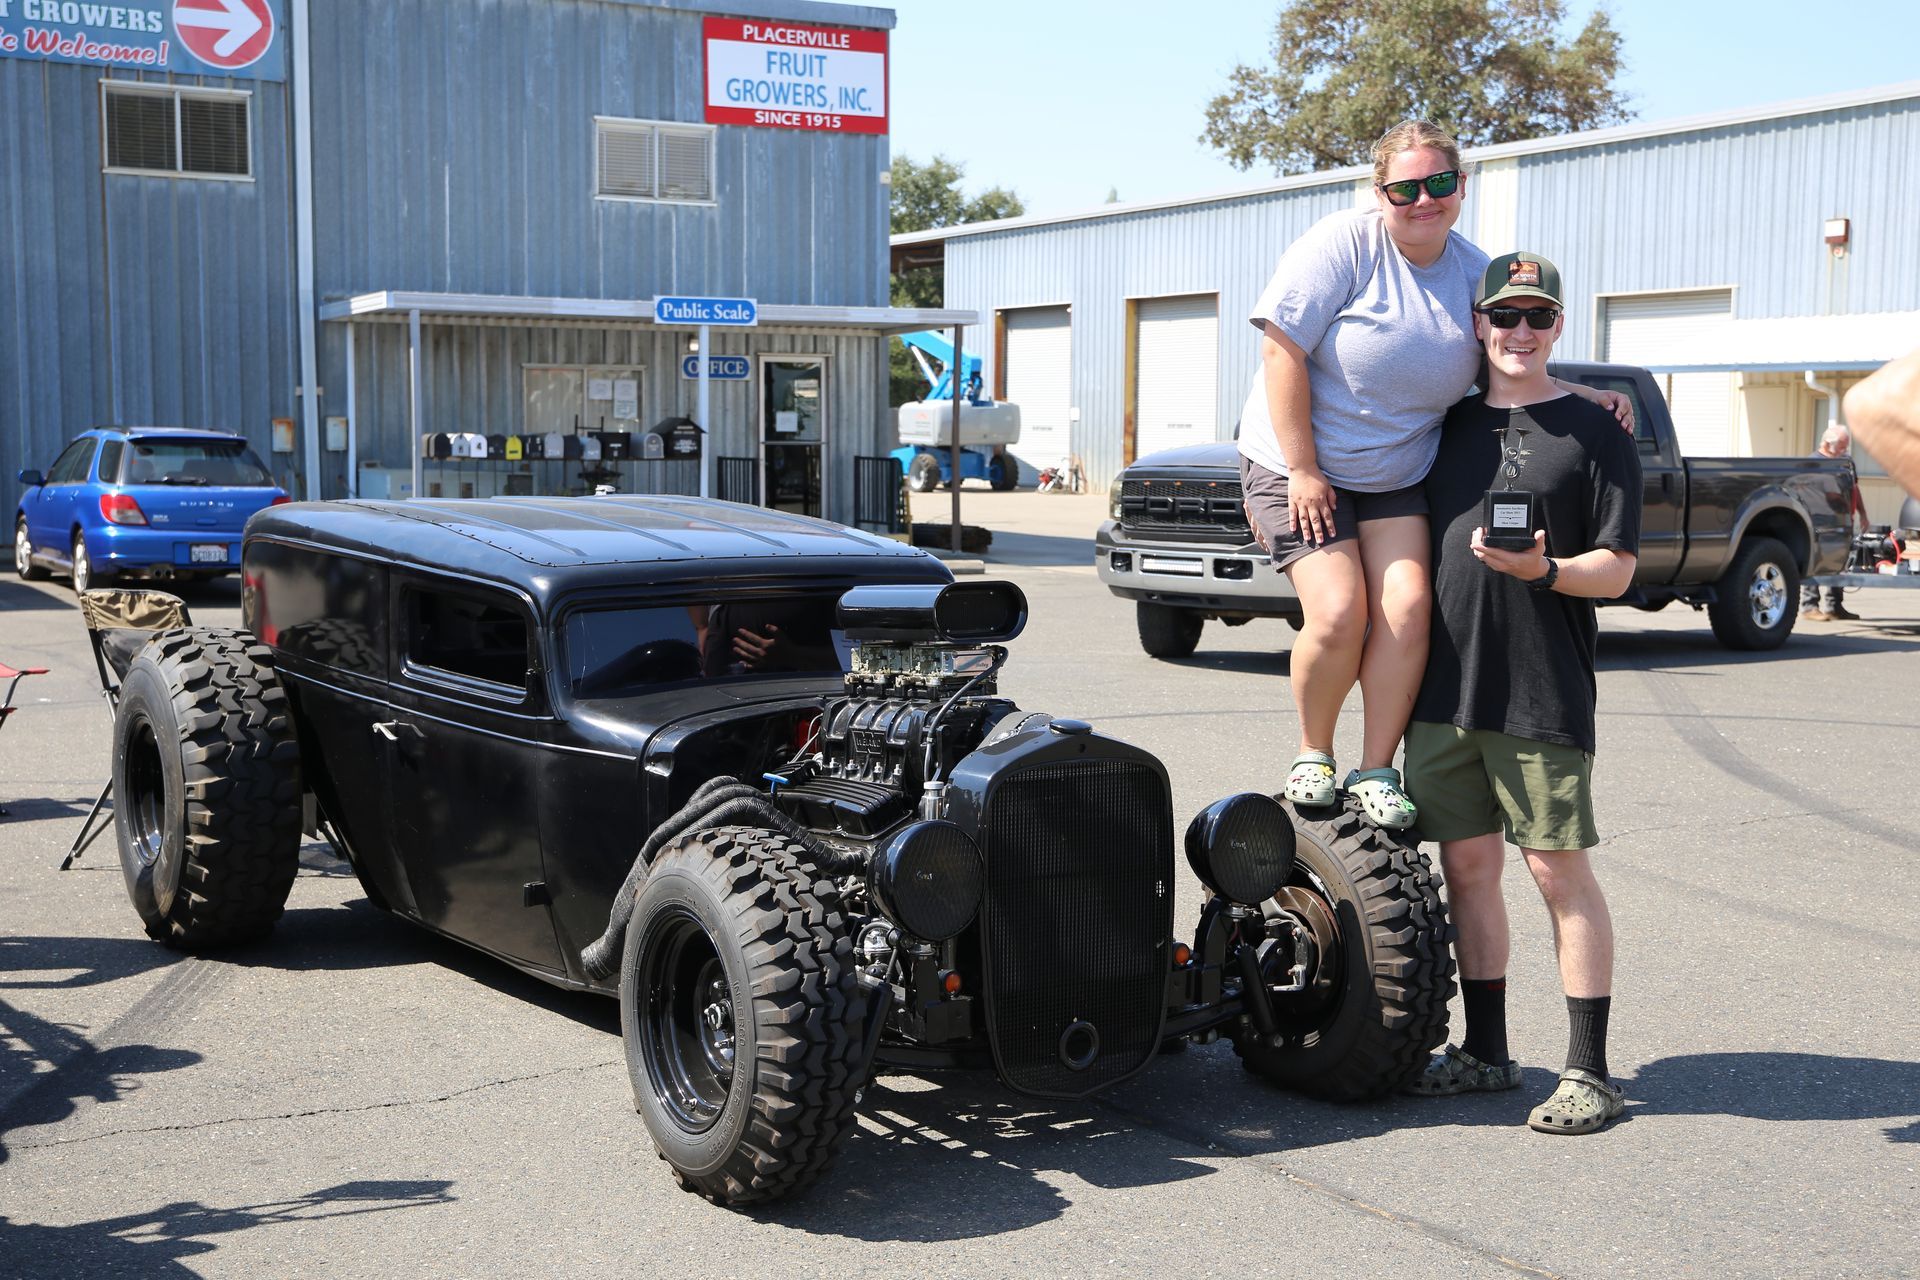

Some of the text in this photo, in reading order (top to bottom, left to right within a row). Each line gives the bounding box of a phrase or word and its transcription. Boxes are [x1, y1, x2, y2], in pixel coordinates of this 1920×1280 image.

[23, 0, 164, 34] GROWERS
[24, 26, 169, 66] Welcome!
[742, 24, 850, 48] PLACERVILLE
[766, 50, 827, 78] FRUIT
[726, 78, 872, 112] GROWERS, INC.
[754, 110, 842, 128] SINCE 1915
[662, 302, 750, 320] Public Scale
[687, 360, 745, 375] OFICE
